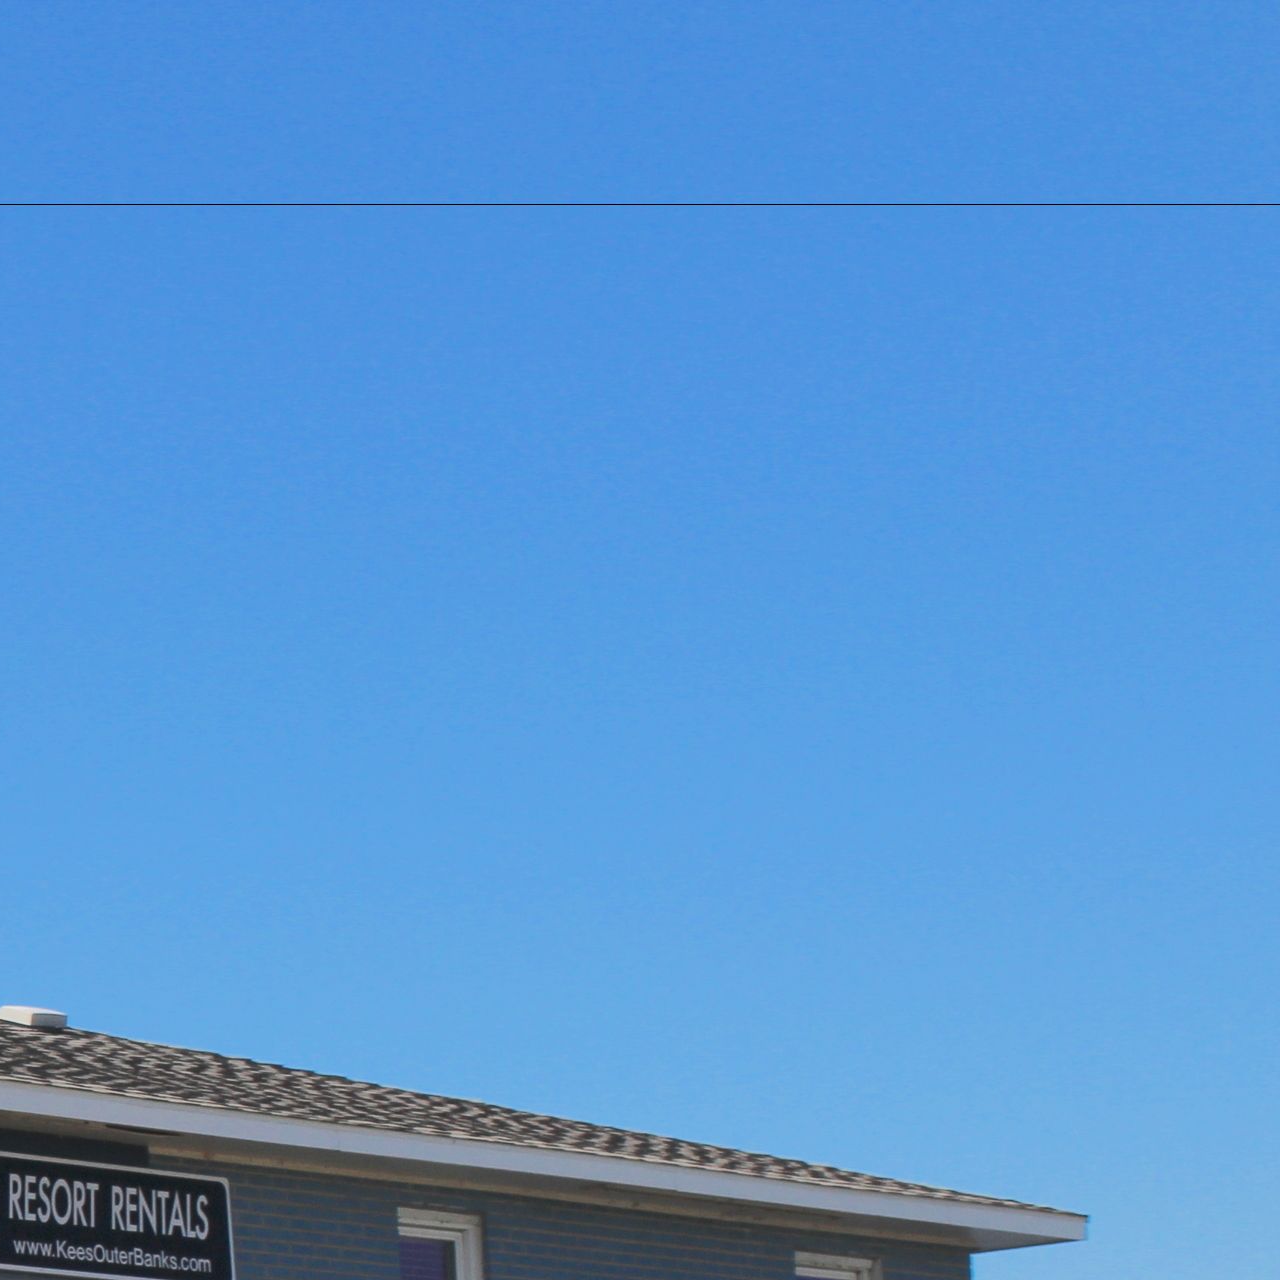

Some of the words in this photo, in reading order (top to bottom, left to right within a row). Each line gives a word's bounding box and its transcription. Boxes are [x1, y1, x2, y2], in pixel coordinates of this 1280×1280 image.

[8, 1173, 100, 1228] RESORT
[111, 1185, 210, 1241] RENTALS
[13, 1239, 212, 1273] www.KeesOuterBanks.com
